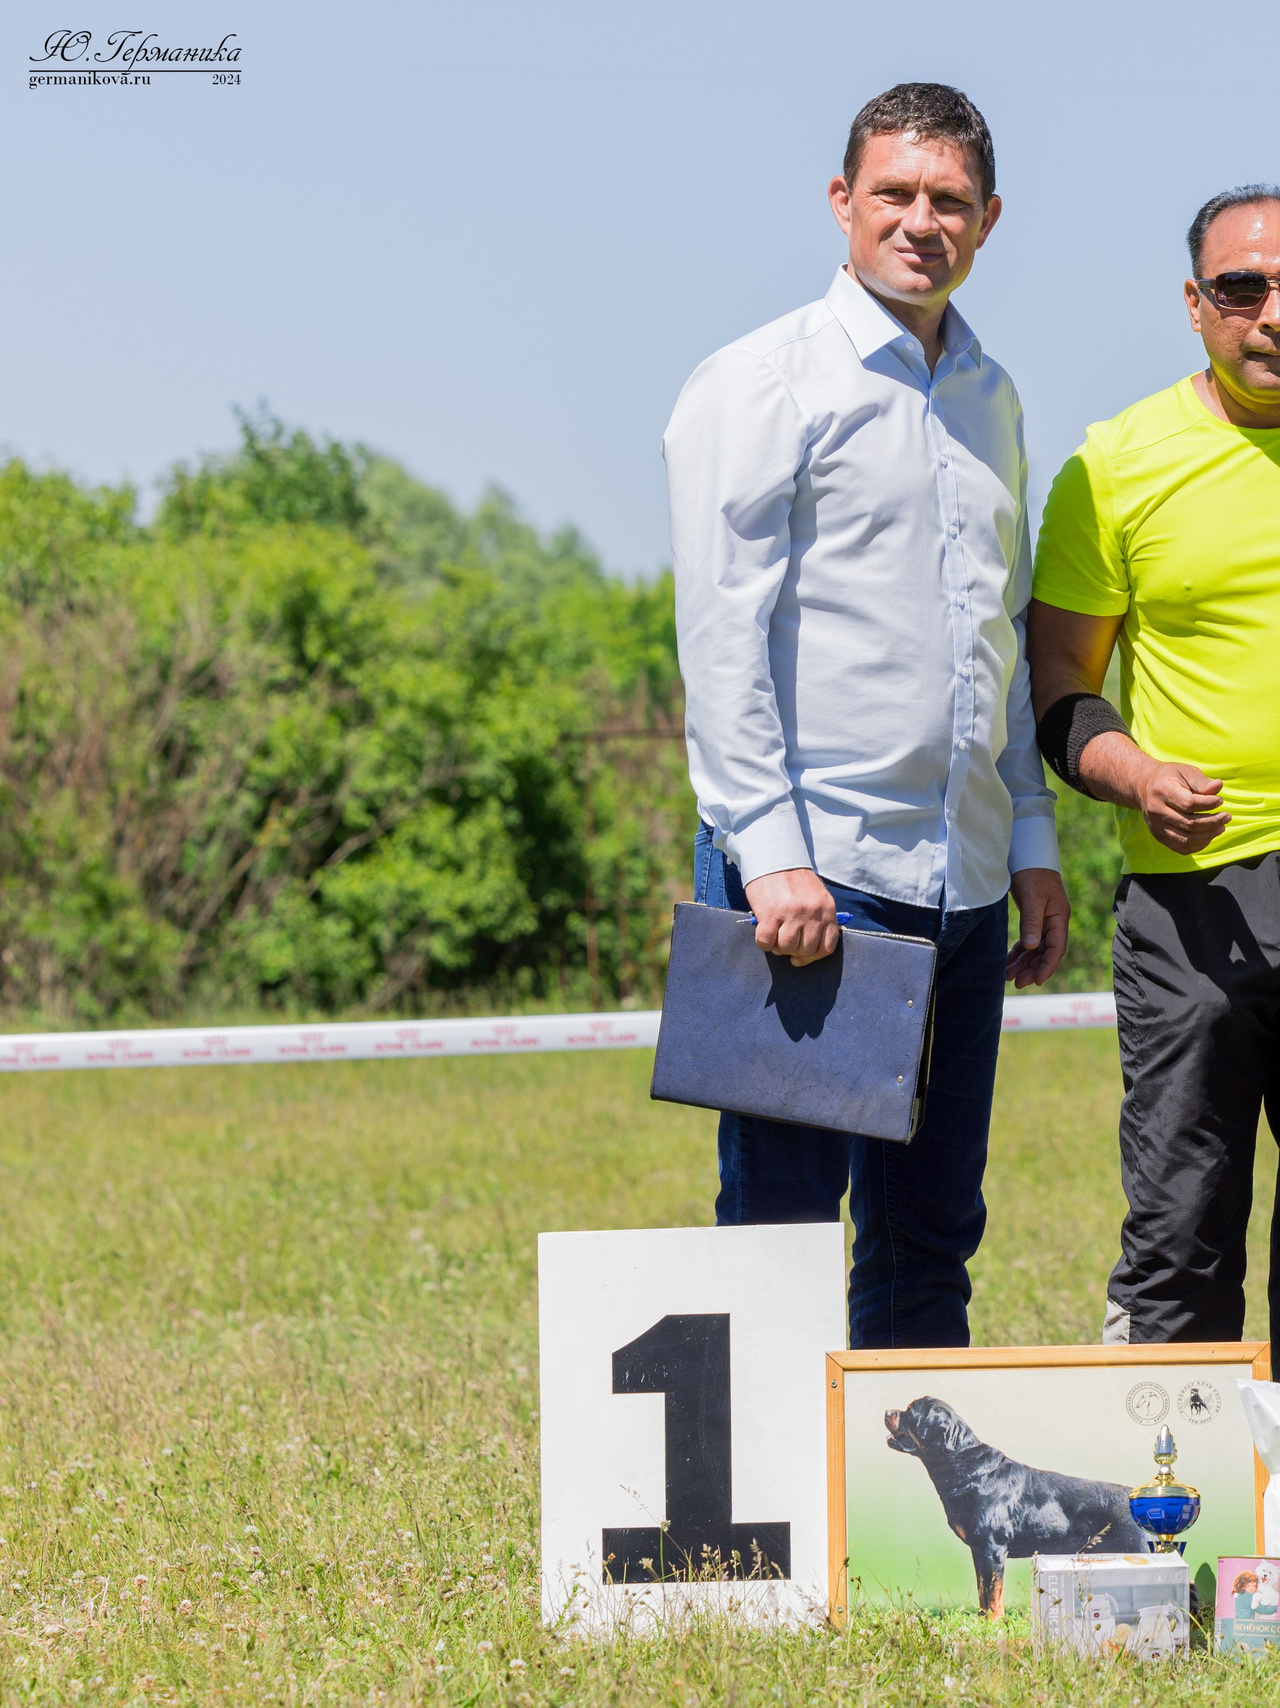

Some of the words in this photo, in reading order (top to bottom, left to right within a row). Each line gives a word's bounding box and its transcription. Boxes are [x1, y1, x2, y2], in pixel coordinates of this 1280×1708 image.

[602, 1312, 791, 1584] 1
[1048, 1574, 1059, 1626] ELECRIC
[1235, 1623, 1270, 1633] ЯГНЁНОК
